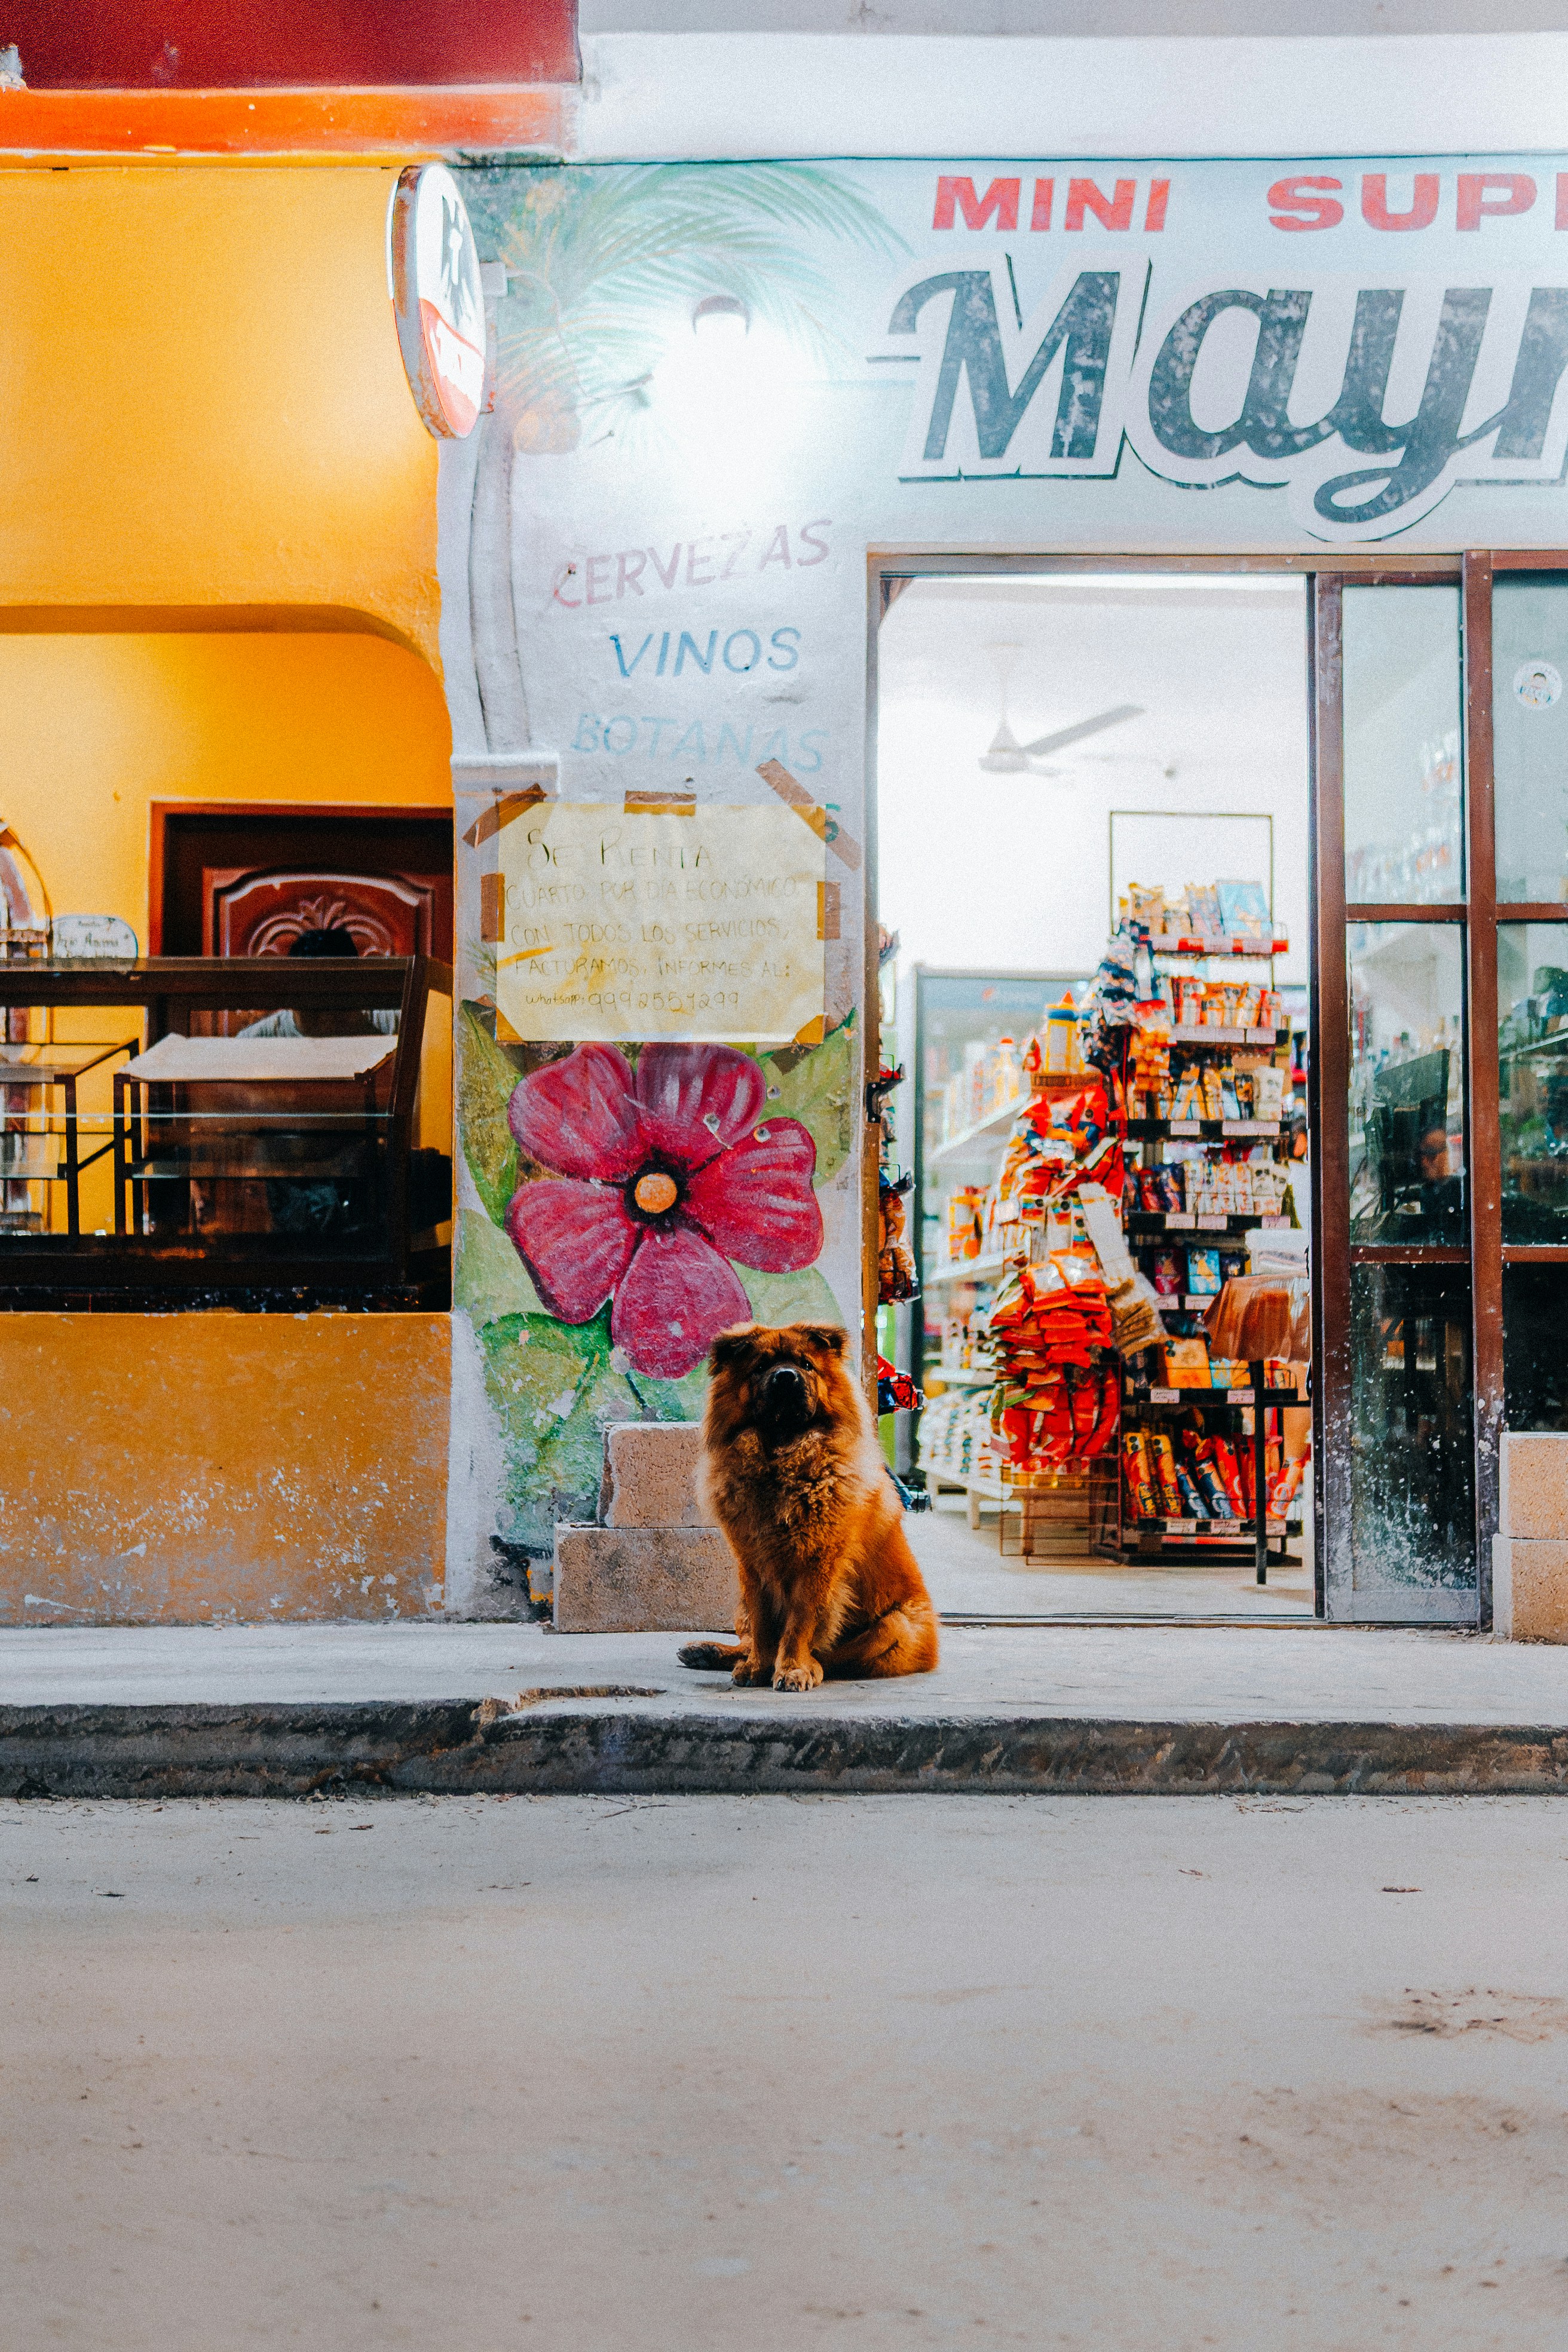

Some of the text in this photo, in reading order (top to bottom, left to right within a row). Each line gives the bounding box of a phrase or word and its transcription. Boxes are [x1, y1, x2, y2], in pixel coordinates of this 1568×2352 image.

[932, 173, 1568, 232] MINI SUP
[552, 519, 832, 608] CERVEZAS
[610, 626, 802, 678] VINOS
[571, 712, 830, 773] BOTANAS
[506, 883, 586, 910] CUARTO
[512, 924, 551, 947] CON
[564, 923, 631, 943] TODOS
[641, 924, 676, 945] LOS
